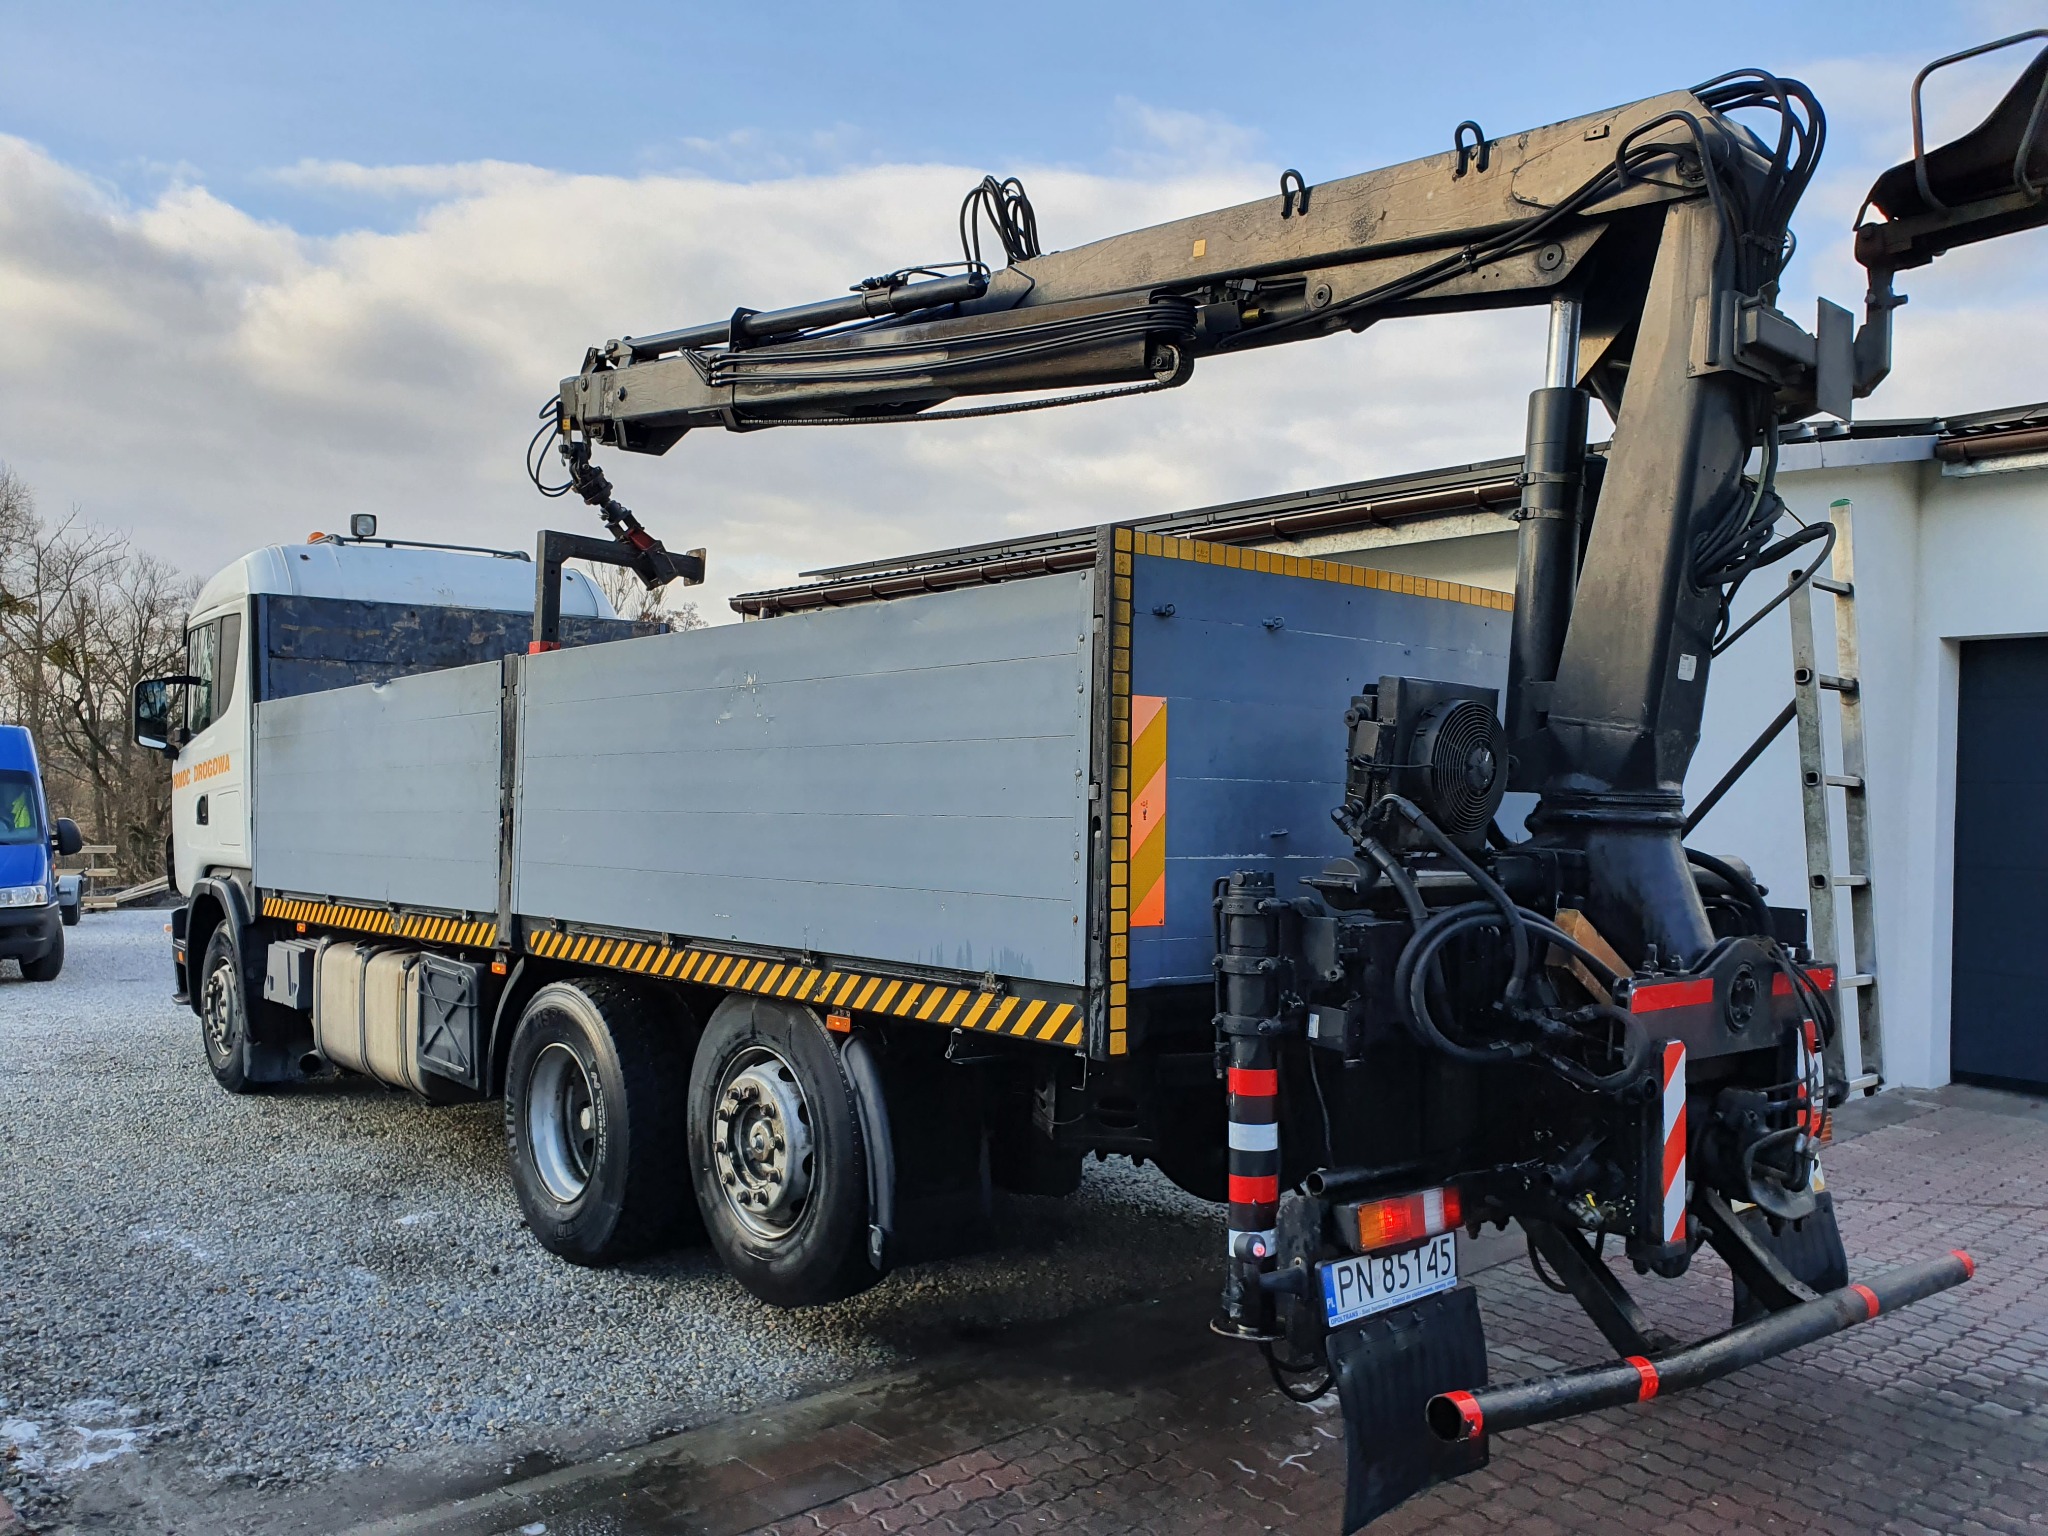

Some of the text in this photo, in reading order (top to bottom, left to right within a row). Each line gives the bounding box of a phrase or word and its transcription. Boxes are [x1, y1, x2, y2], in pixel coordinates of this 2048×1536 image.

[173, 753, 230, 789] POMOC DROGOWA
[1337, 1237, 1452, 1308] PN 85145
[1326, 1297, 1336, 1310] PL
